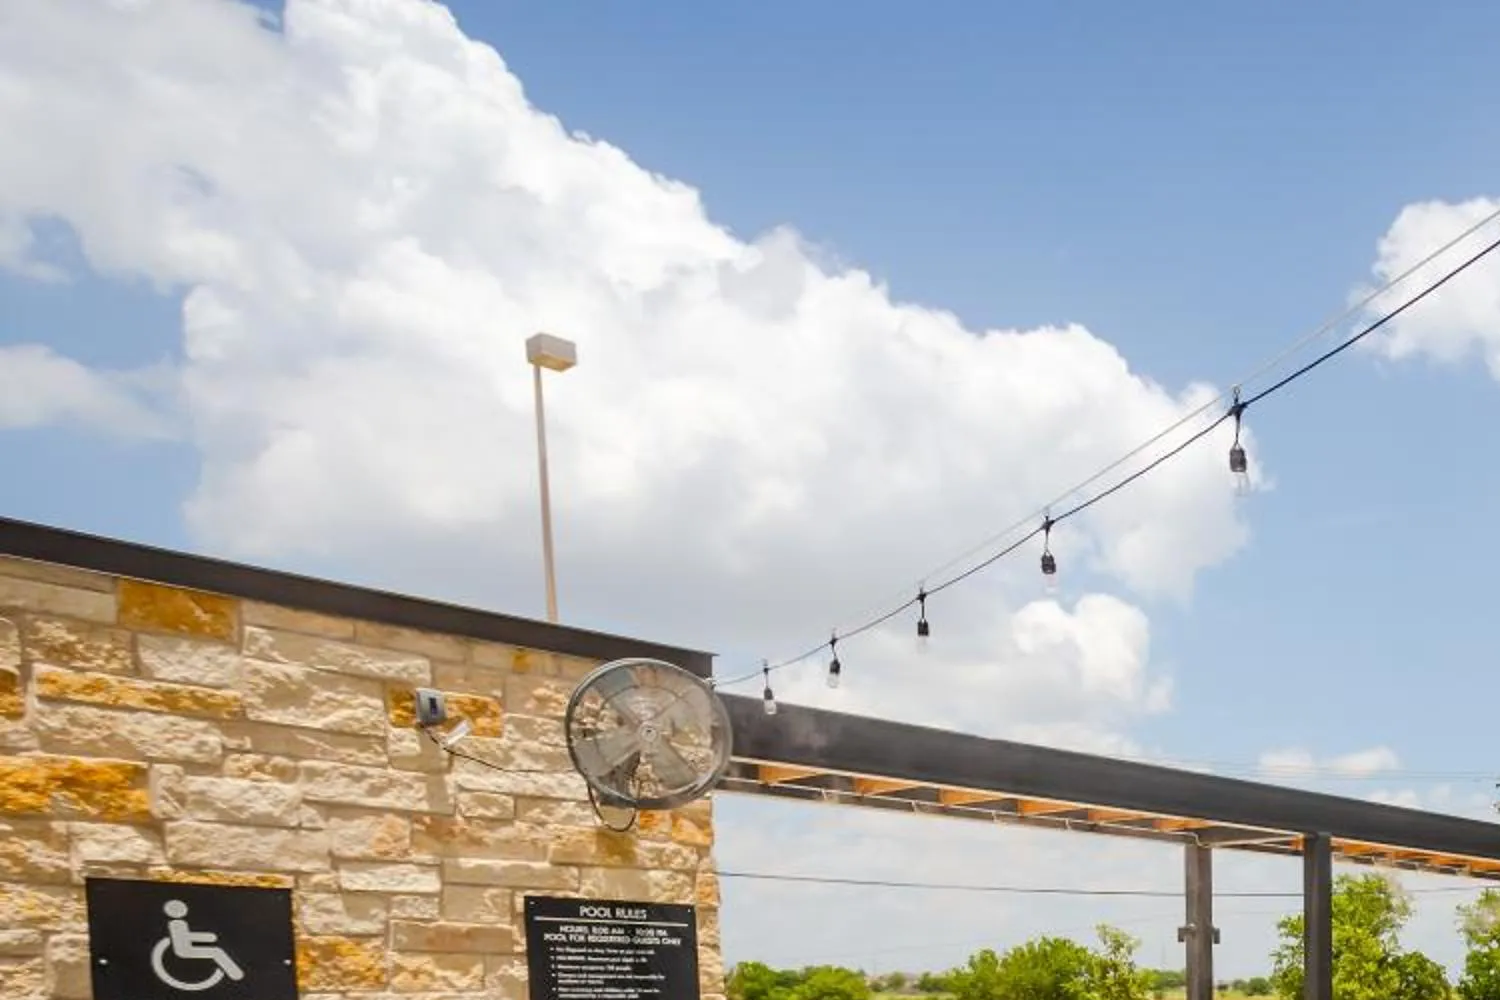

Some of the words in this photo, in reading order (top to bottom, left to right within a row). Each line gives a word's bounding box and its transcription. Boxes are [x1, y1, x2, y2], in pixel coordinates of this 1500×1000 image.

[579, 905, 612, 918] POOL
[615, 907, 647, 920] RULES
[543, 932, 568, 942] POOL
[569, 933, 586, 943] FOR
